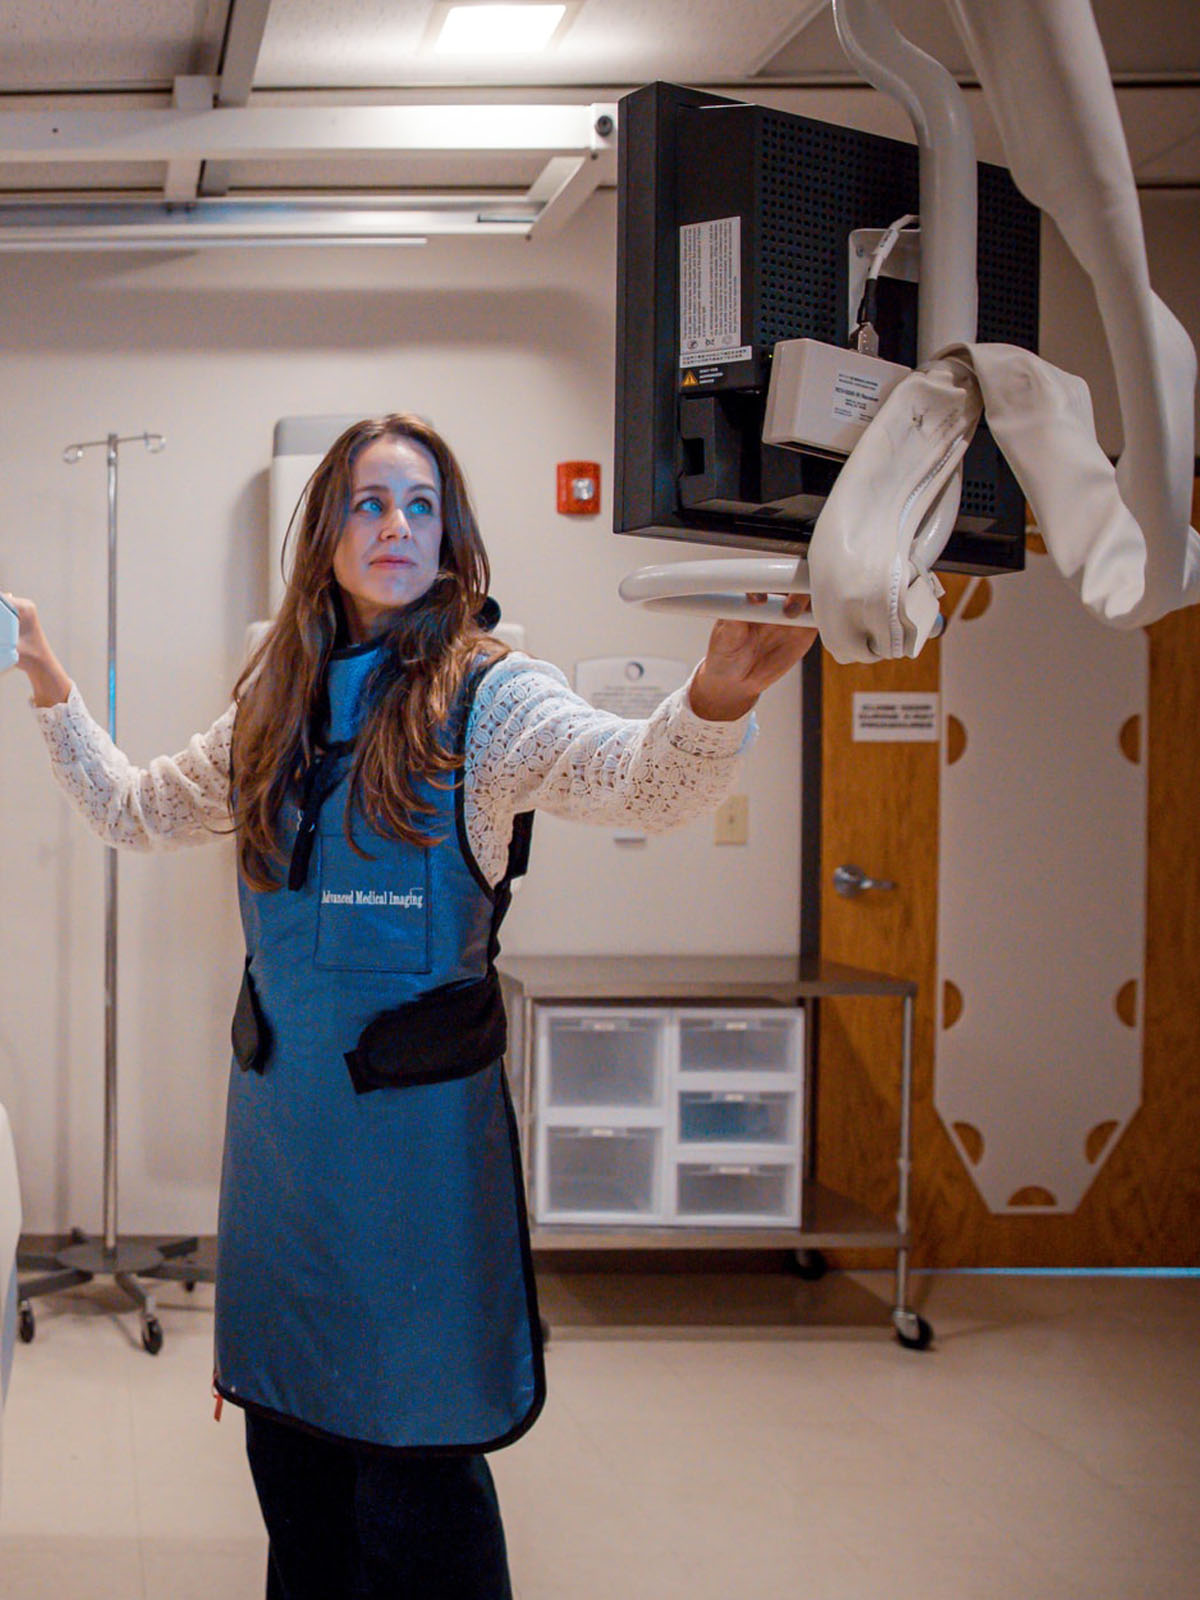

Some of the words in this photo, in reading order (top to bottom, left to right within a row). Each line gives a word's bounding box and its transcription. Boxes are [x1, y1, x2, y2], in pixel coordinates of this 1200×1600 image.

[321, 890, 354, 905] Advanced
[355, 890, 388, 905] Medical
[389, 889, 423, 909] Imaging
